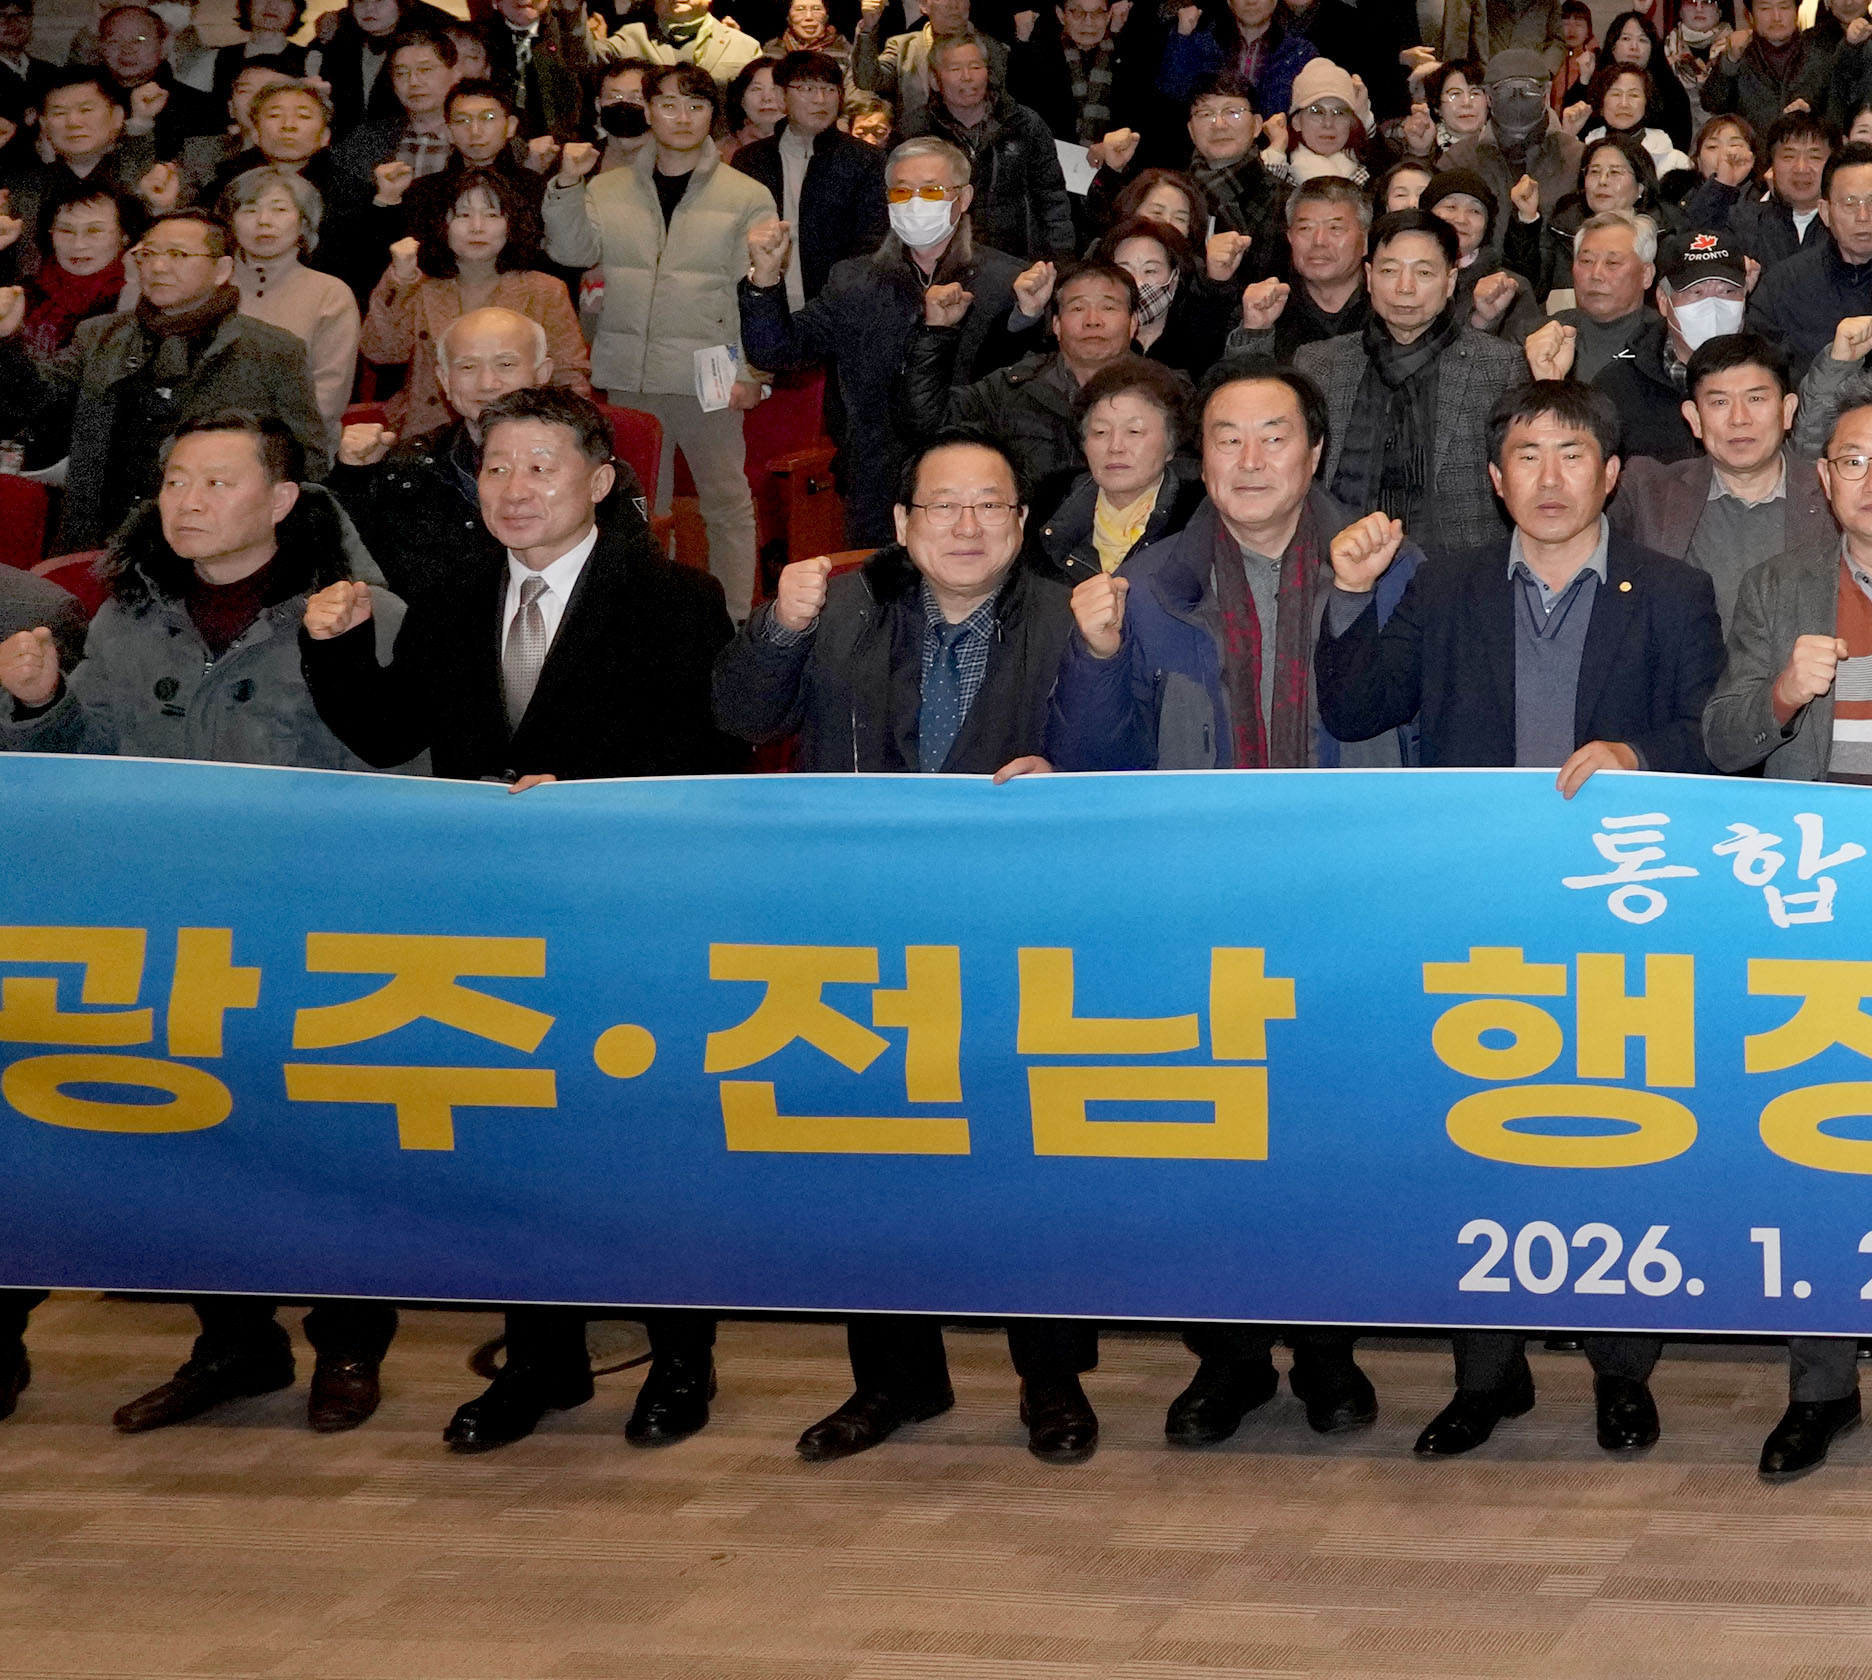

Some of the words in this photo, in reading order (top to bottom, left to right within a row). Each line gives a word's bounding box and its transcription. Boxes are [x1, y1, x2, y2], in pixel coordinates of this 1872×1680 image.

[1684, 250, 1729, 261] TORONTO
[0, 925, 1297, 1161] 광주·전남
[1457, 1218, 1705, 1297] 2026.
[1750, 1227, 1812, 1299] 1.
